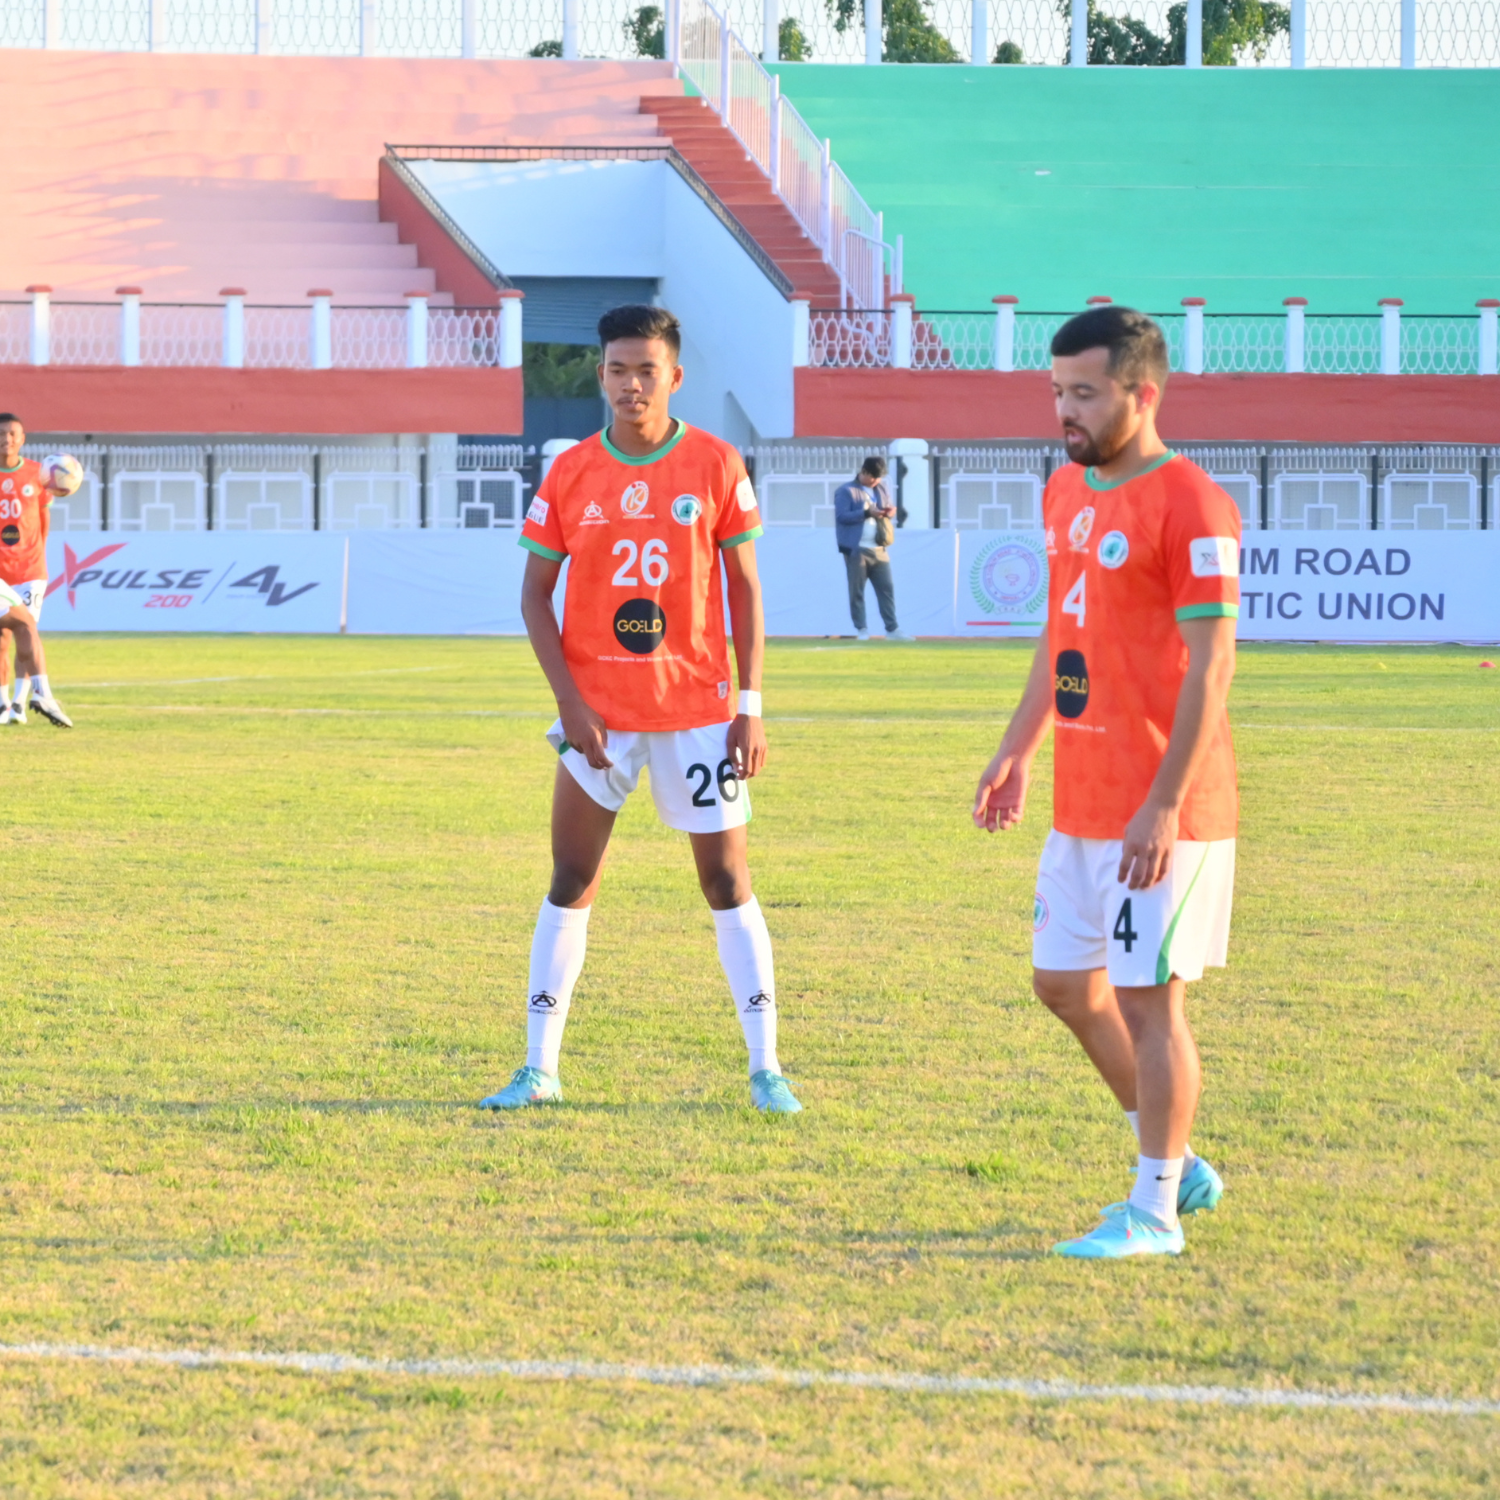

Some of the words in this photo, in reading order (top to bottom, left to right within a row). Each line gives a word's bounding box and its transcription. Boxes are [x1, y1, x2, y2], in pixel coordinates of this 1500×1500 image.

[611, 538, 669, 587] 26
[1295, 548, 1411, 576] ROAD
[143, 594, 194, 608] 200
[1062, 570, 1086, 627] 4
[1241, 592, 1303, 620] TIC
[1318, 592, 1445, 620] UNION
[685, 757, 740, 807] 26
[1113, 897, 1138, 953] 4
